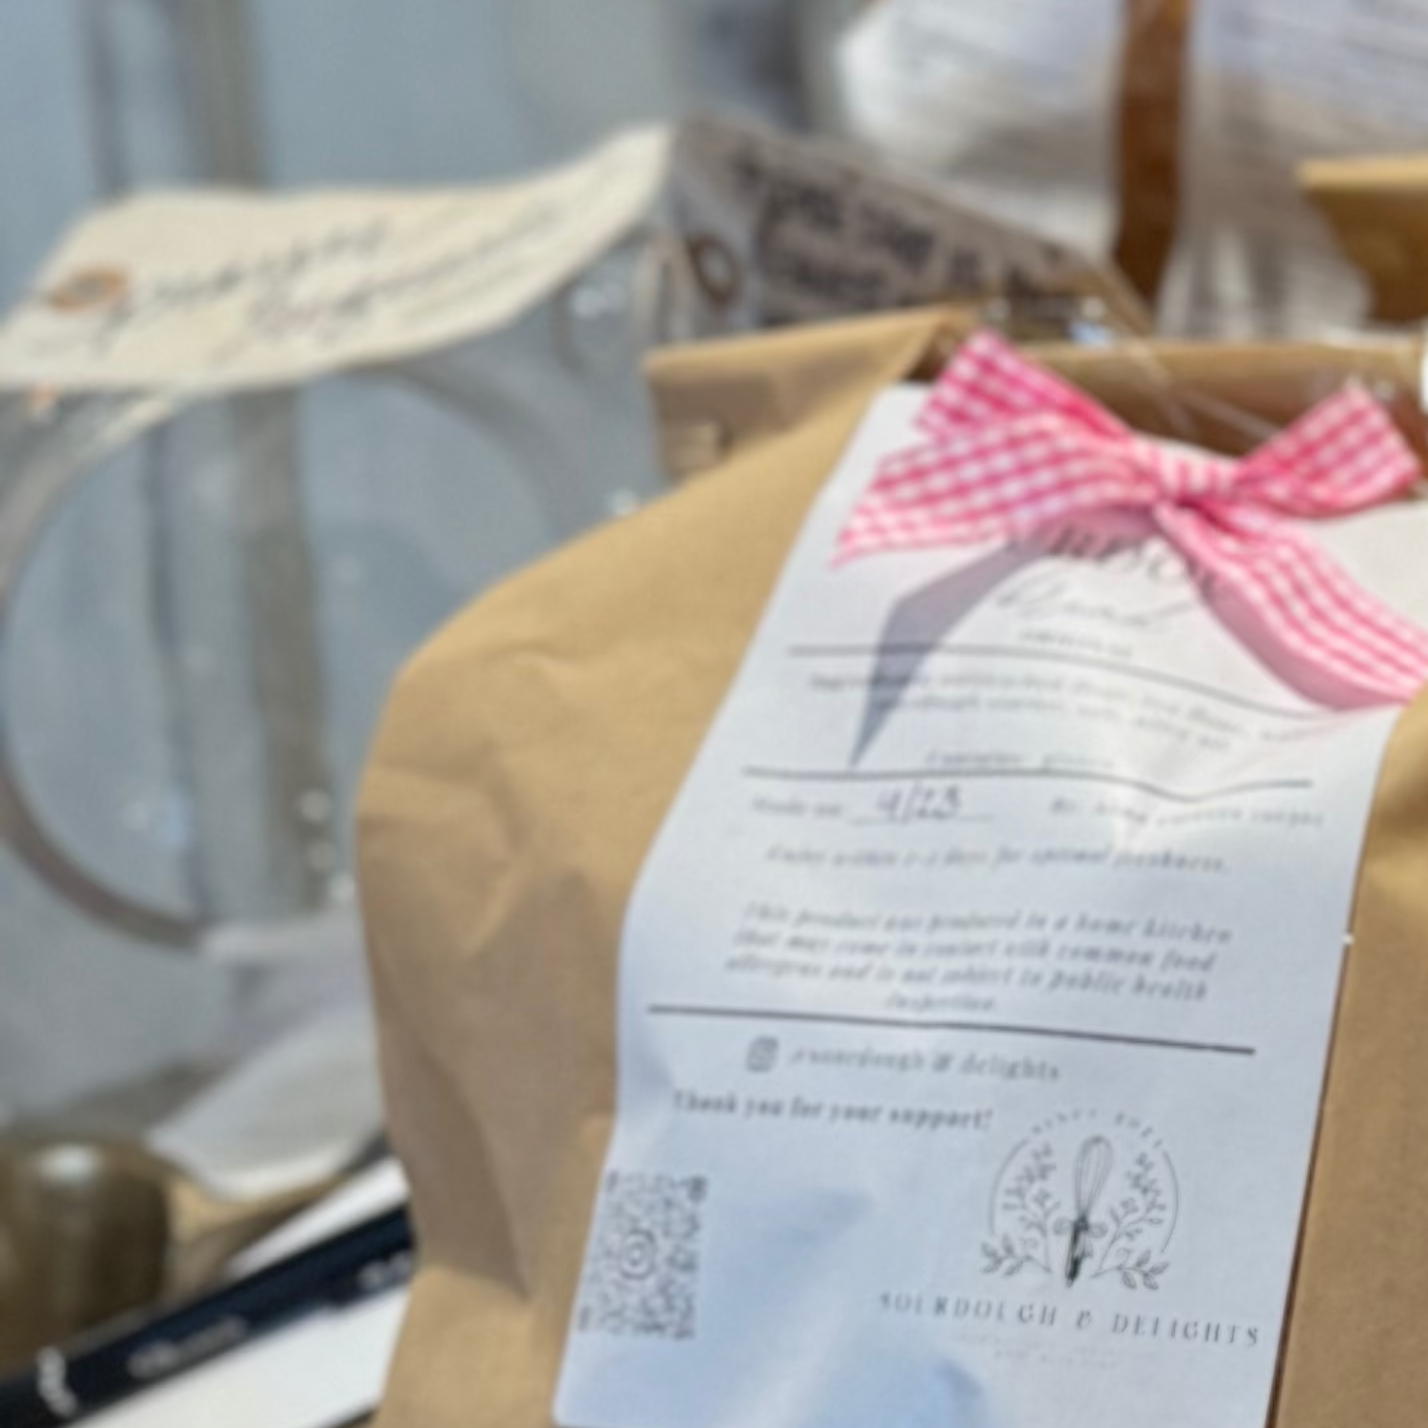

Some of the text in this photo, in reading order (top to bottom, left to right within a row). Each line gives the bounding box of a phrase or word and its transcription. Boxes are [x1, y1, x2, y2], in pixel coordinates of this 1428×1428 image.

[673, 1090, 995, 1133] Thank you for your support!
[880, 1289, 1058, 1328] SOURDOUGH
[1075, 1308, 1095, 1330] &
[1110, 1311, 1261, 1348] DELIGHTS
